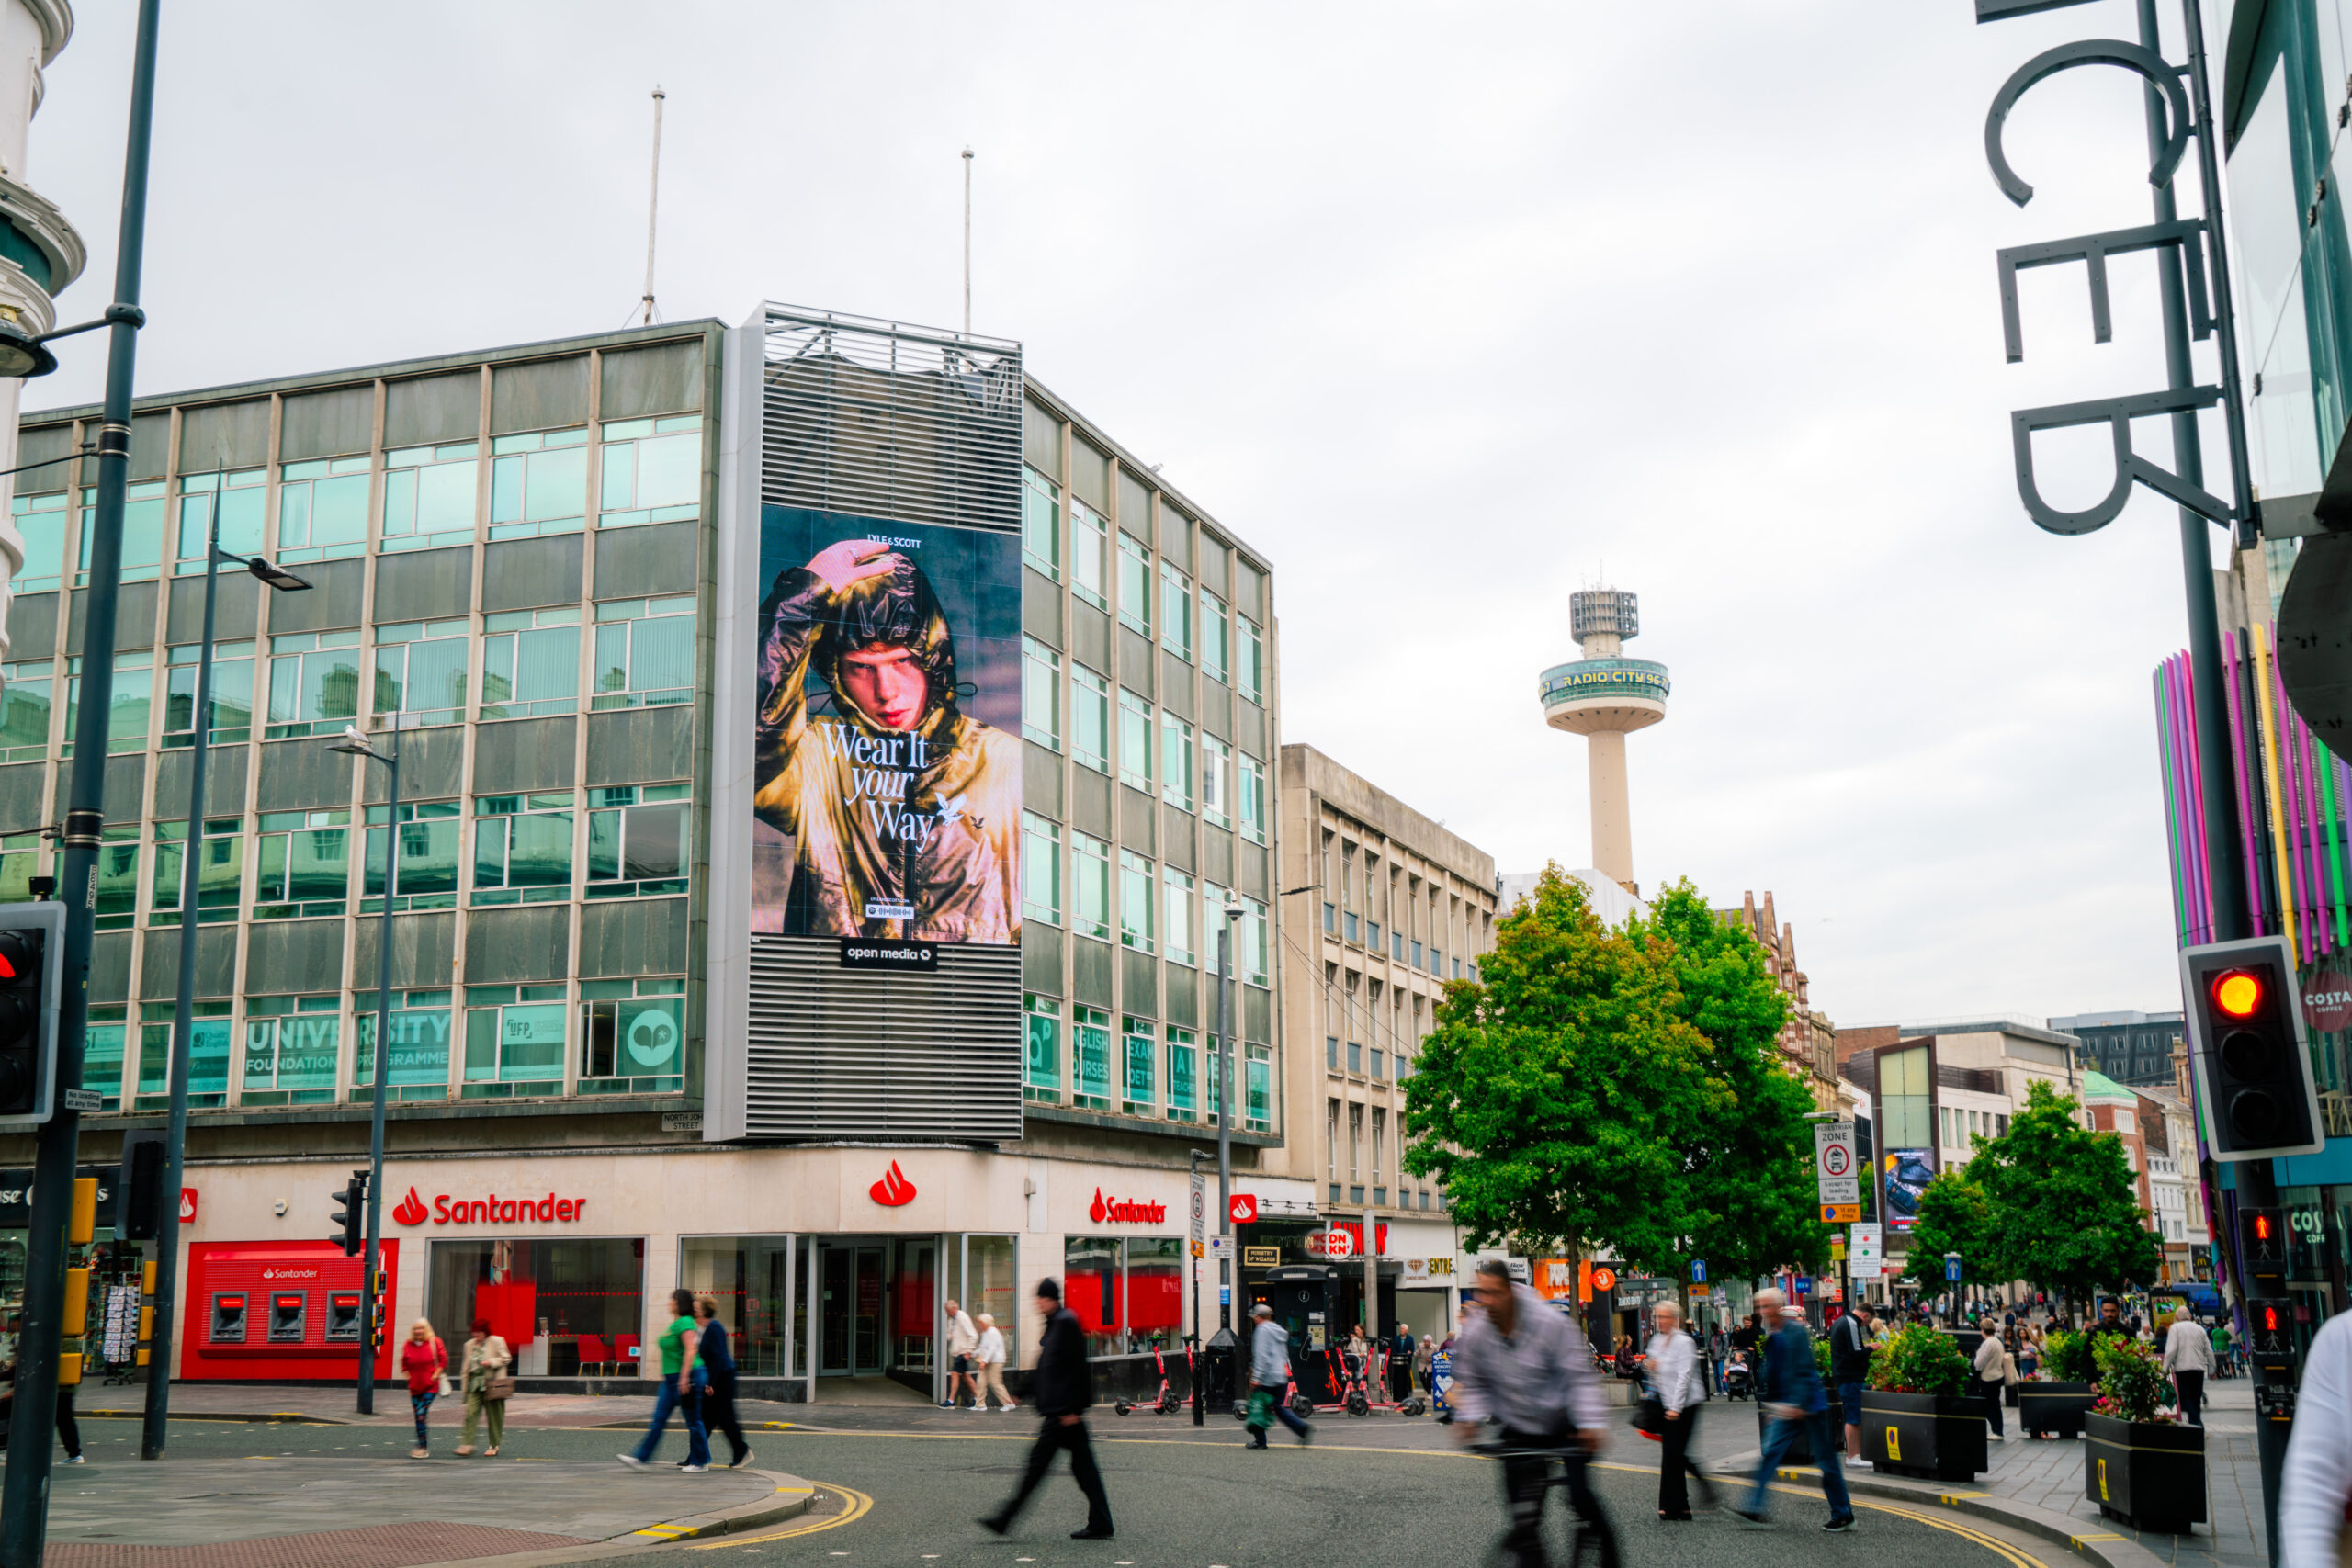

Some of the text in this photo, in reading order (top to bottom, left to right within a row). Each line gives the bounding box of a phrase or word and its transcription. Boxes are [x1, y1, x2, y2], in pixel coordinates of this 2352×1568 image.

[1563, 672, 1608, 687] RADIO
[1612, 671, 1644, 682] CITY
[820, 722, 930, 769] Wear It
[843, 767, 915, 807] your
[865, 799, 936, 854] Way.
[847, 947, 918, 960] open media
[2304, 989, 2352, 1006] COSTA
[2316, 1005, 2343, 1014] COFFEE
[247, 1014, 451, 1051] UNIVERSITY
[509, 1021, 530, 1037] UFP
[1073, 1029, 1109, 1052] NGLISH
[357, 1051, 448, 1066] PROGRAMME
[1129, 1040, 1154, 1061] EXAM
[246, 1056, 337, 1072] FOUNDATION
[1073, 1057, 1109, 1080] OURSES
[1176, 1050, 1186, 1075] A
[78, 1092, 100, 1100] loading
[664, 1113, 688, 1122] NORTH
[673, 1122, 699, 1130] STREET
[1822, 1132, 1849, 1142] ZONE
[433, 1191, 586, 1224] Santander
[1106, 1196, 1167, 1224] Santander
[1329, 1234, 1347, 1244] DN
[2306, 1234, 2325, 1244] COFF
[275, 1269, 318, 1278] Santander
[1428, 1258, 1453, 1275] ENTRE
